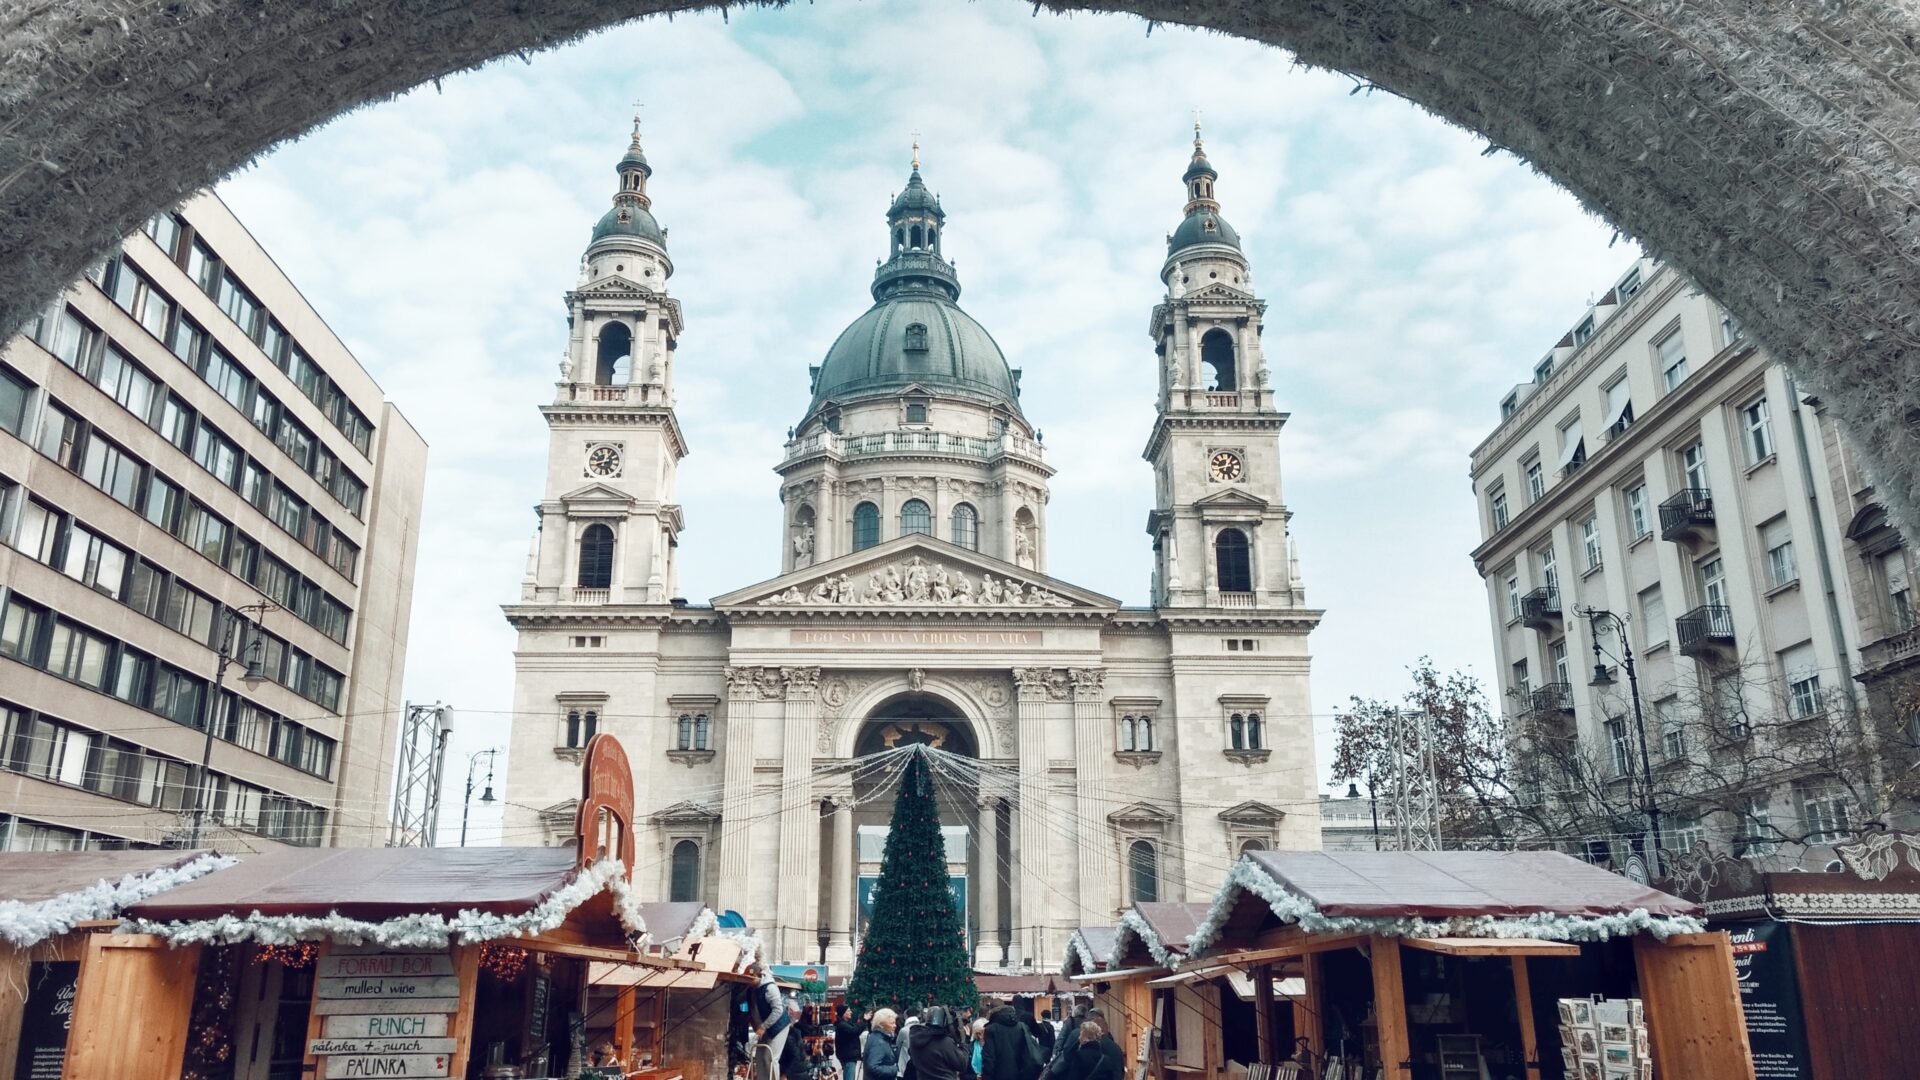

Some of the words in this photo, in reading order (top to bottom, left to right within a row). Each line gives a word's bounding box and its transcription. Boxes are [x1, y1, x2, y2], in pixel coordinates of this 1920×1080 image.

[804, 632, 833, 643] EGO
[841, 632, 872, 643] SUM
[880, 632, 904, 643] VIA
[912, 632, 968, 644] VERITAS
[975, 633, 990, 643] ET
[1000, 632, 1029, 644] VITA
[338, 957, 396, 975] FORRALT
[402, 957, 433, 973] BOR
[344, 980, 383, 994] mulled
[390, 984, 415, 993] wine
[368, 1017, 426, 1036] PUNCH
[311, 1040, 358, 1053] pálinka
[383, 1040, 423, 1054] punch
[346, 1057, 407, 1076] PÁLINKA
